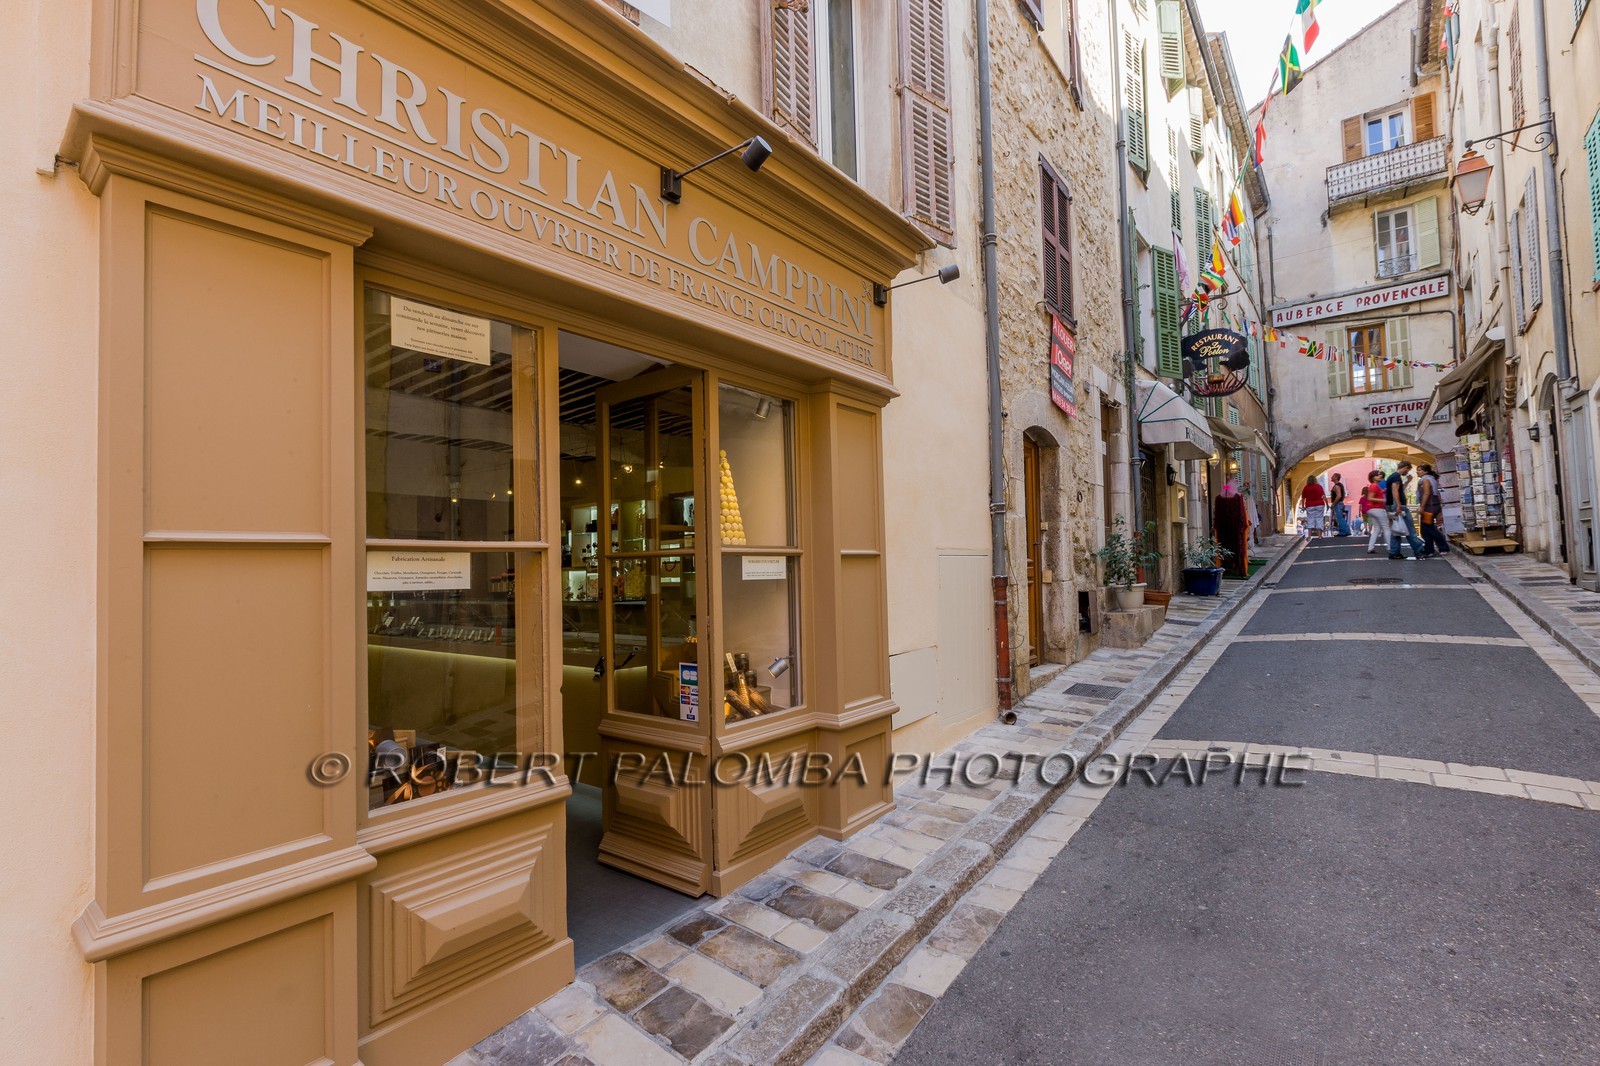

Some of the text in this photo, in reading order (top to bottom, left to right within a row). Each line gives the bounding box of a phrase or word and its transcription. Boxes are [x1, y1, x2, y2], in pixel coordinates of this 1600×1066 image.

[196, 0, 873, 339] CHRISTIAN CAMPRINI
[195, 73, 874, 368] MEILLEUR OUVRIER DE FRANCE CHOCOLATIER
[1276, 281, 1445, 323] AUBERGE PROVENCALE
[1191, 333, 1239, 351] RESTAURANT
[1371, 401, 1430, 415] RESTAUR
[1372, 414, 1412, 426] HOTEL
